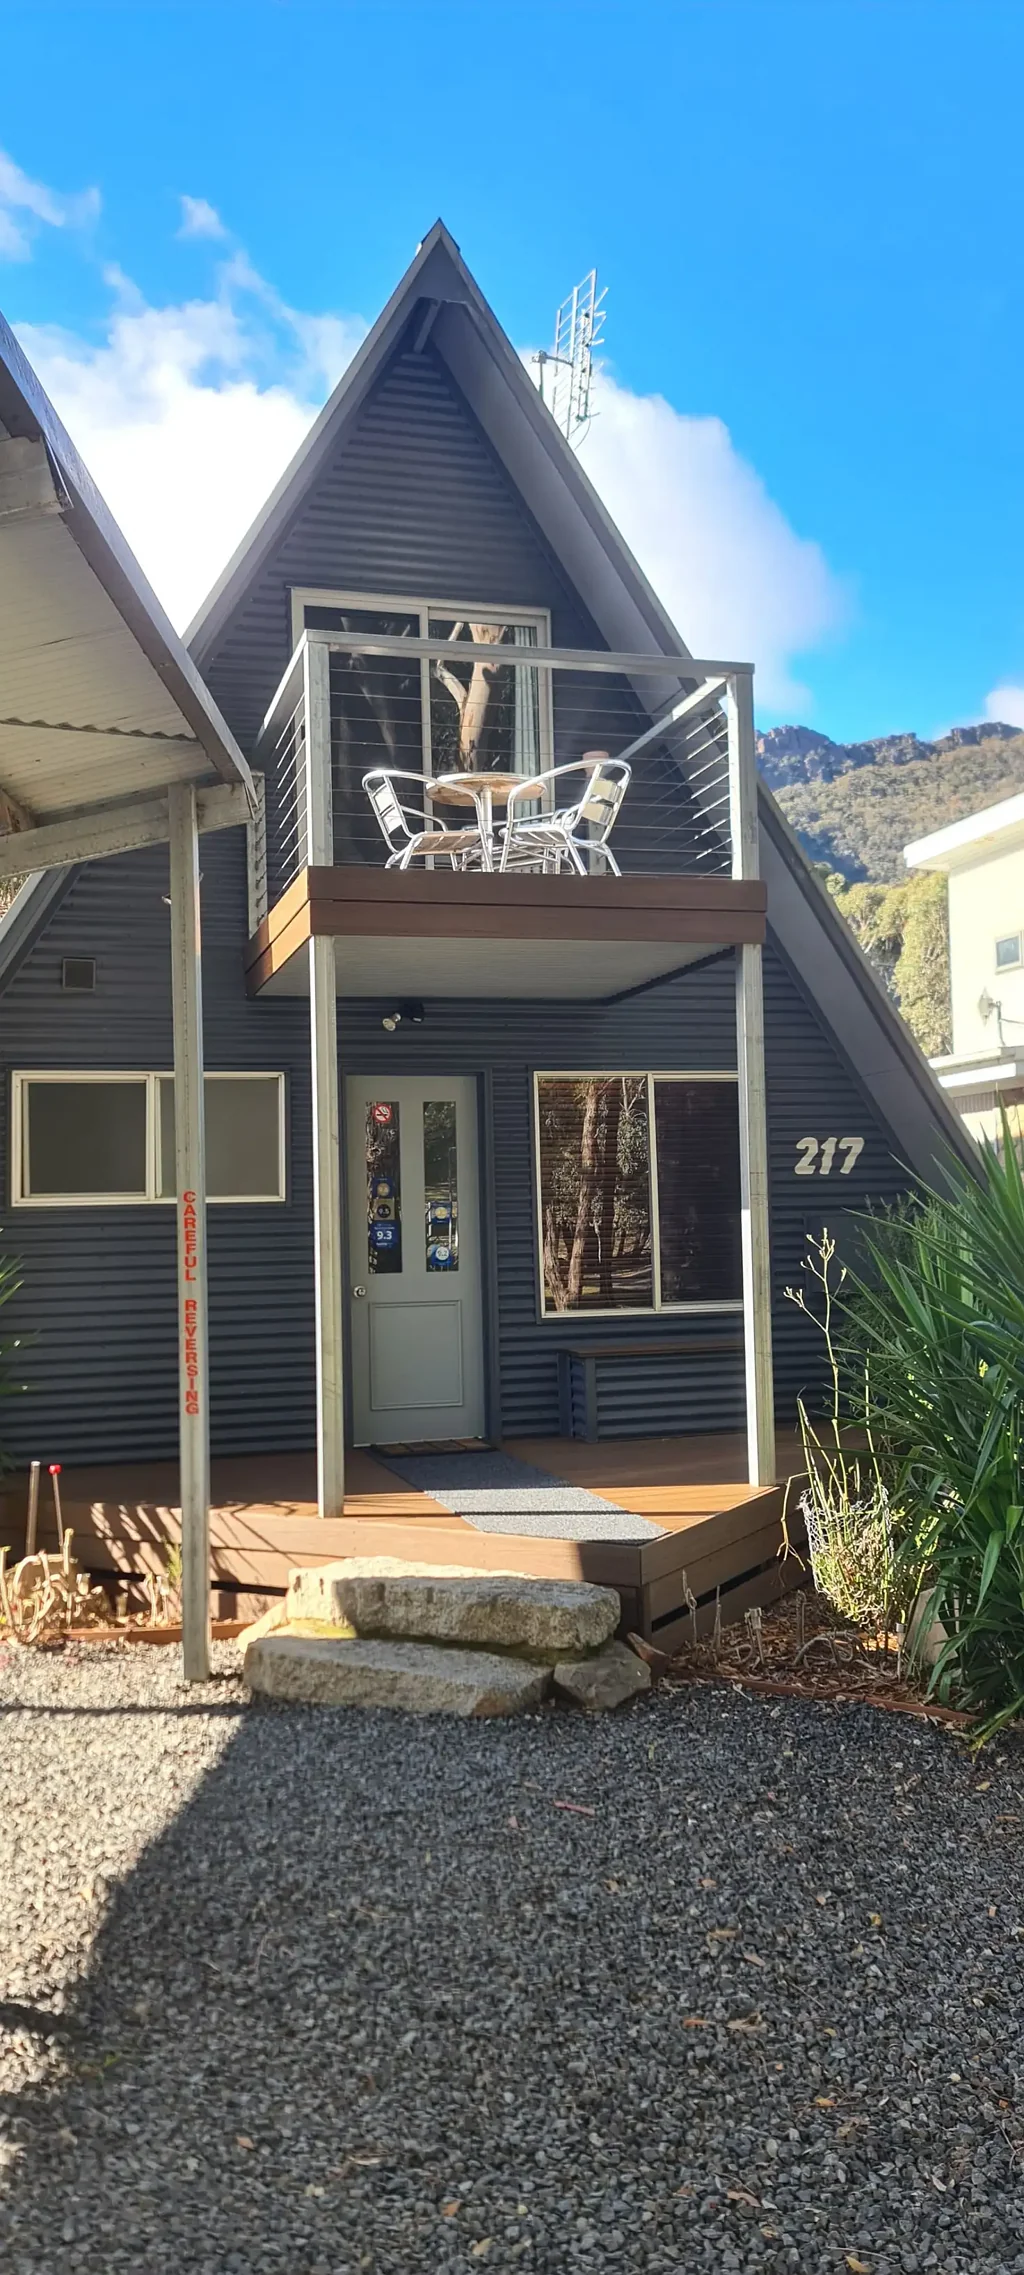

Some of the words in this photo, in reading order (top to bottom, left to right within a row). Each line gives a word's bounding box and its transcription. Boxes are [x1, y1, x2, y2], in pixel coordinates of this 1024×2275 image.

[794, 1136, 865, 1175] 217
[183, 1191, 198, 1281] CAREFUL
[376, 1230, 392, 1240] 9.3
[184, 1298, 199, 1415] REVERSING
